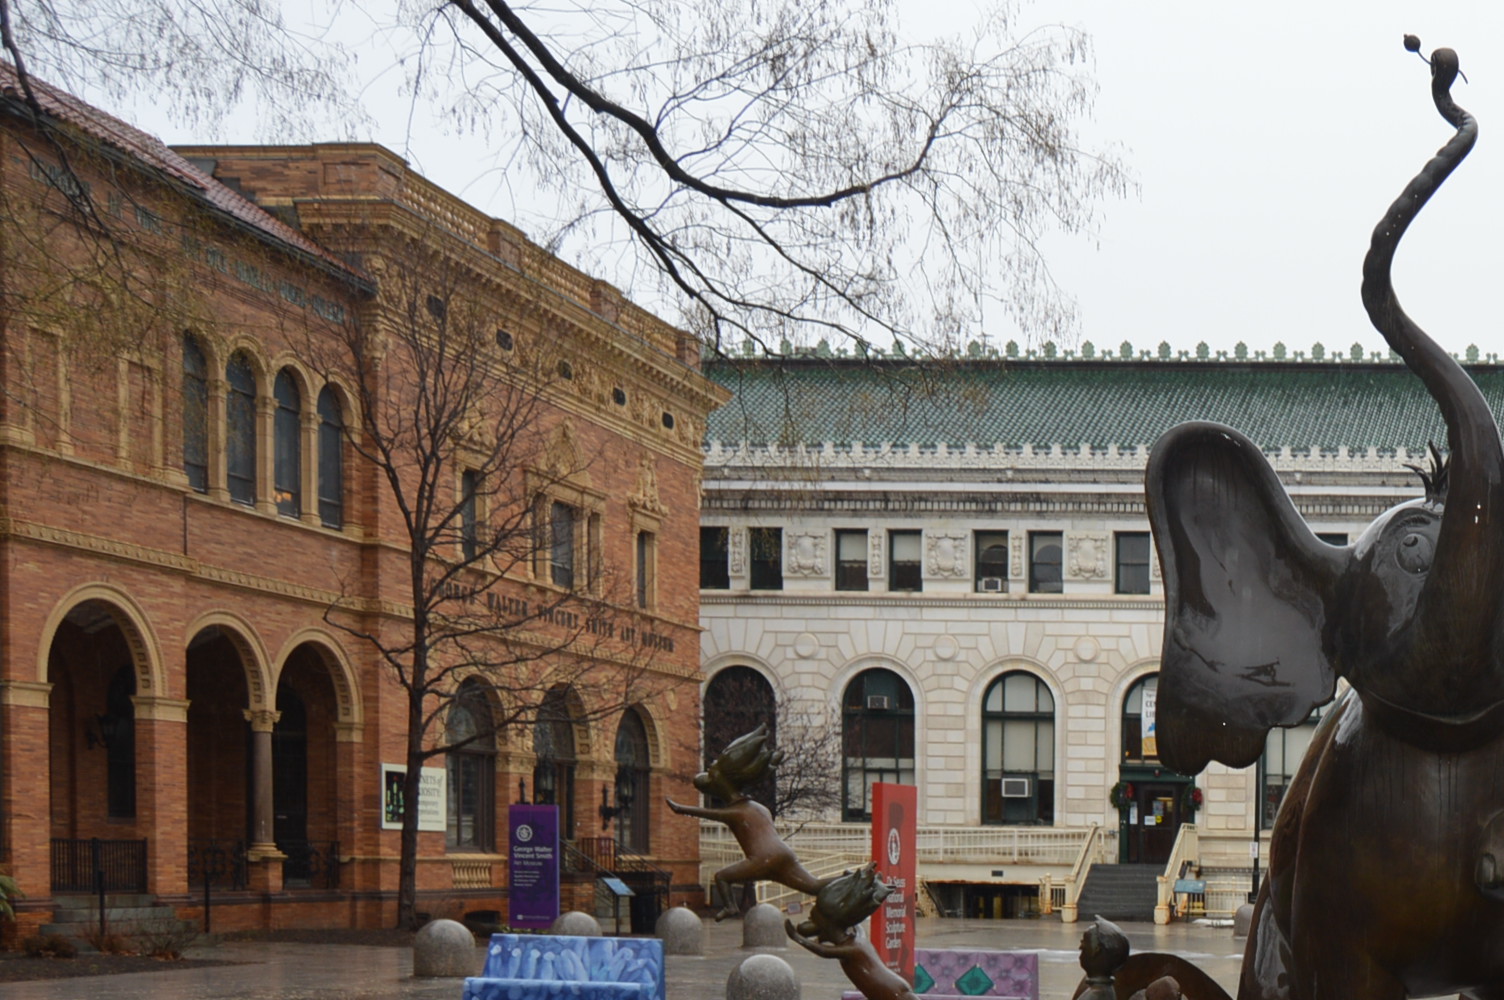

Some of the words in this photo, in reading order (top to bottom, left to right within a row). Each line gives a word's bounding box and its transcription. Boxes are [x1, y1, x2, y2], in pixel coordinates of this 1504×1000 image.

[486, 591, 528, 617] WALTER
[536, 603, 579, 630] VINCENT
[585, 615, 614, 639] SMITH
[620, 625, 636, 644] ART
[640, 631, 675, 653] MUSEUM
[886, 905, 907, 918] Memorial
[885, 920, 907, 936] Sculpture
[885, 935, 902, 949] Garden
